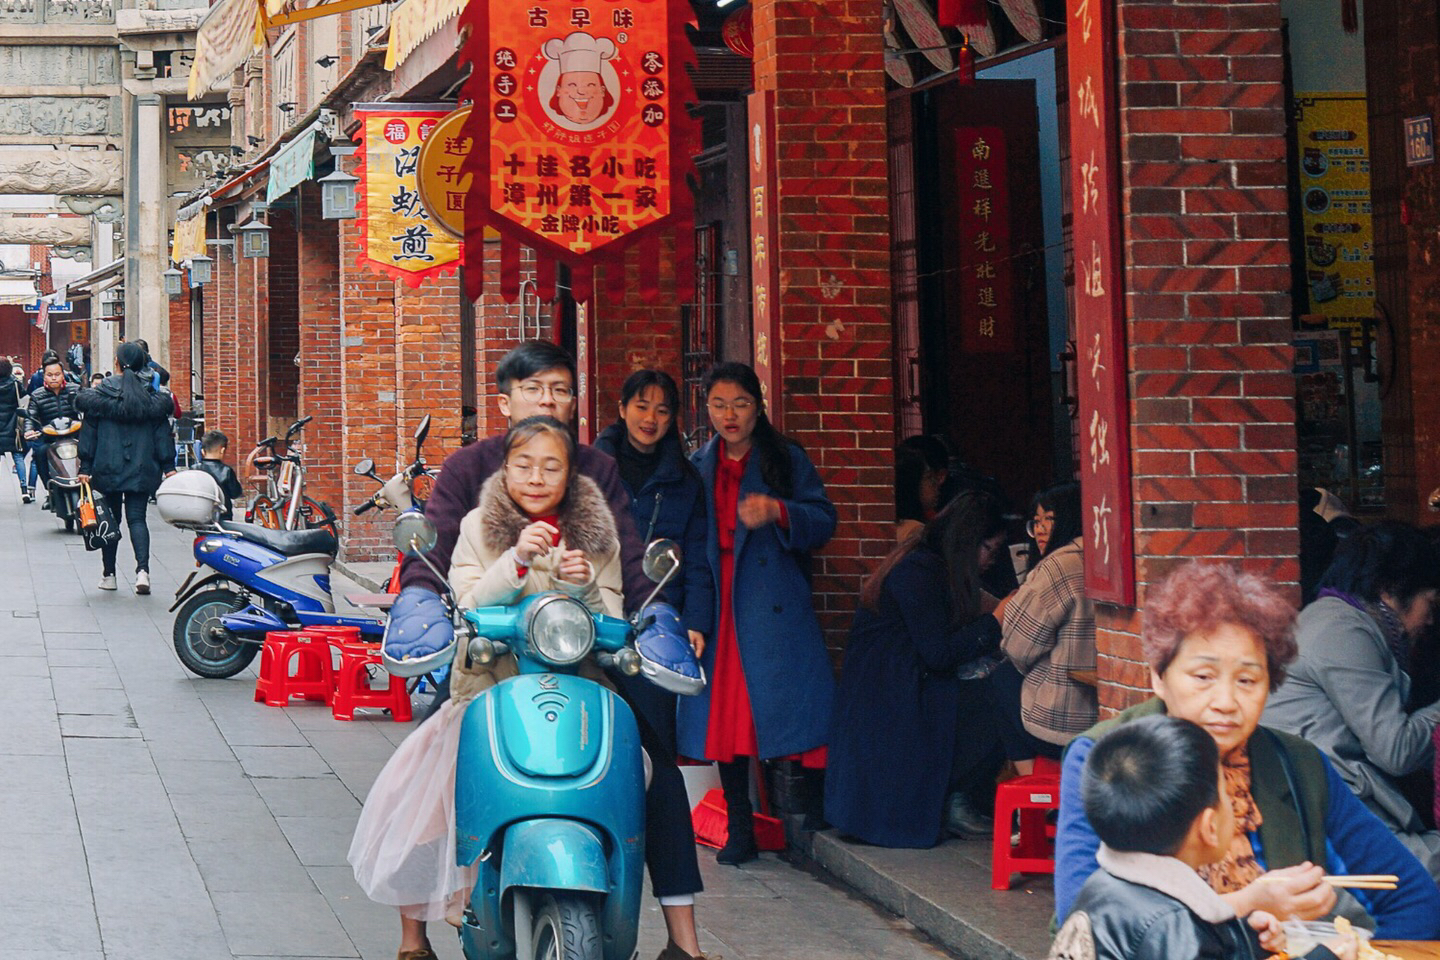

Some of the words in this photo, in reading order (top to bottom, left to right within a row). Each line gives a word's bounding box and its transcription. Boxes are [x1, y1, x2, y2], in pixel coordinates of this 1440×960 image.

[528, 6, 634, 29] 古早味
[496, 49, 516, 118] 纯手工
[643, 52, 664, 124] 零添加
[503, 153, 657, 179] 十佳名小吃
[503, 182, 658, 208] 漳州第一家
[541, 214, 620, 234] 金牌小吃
